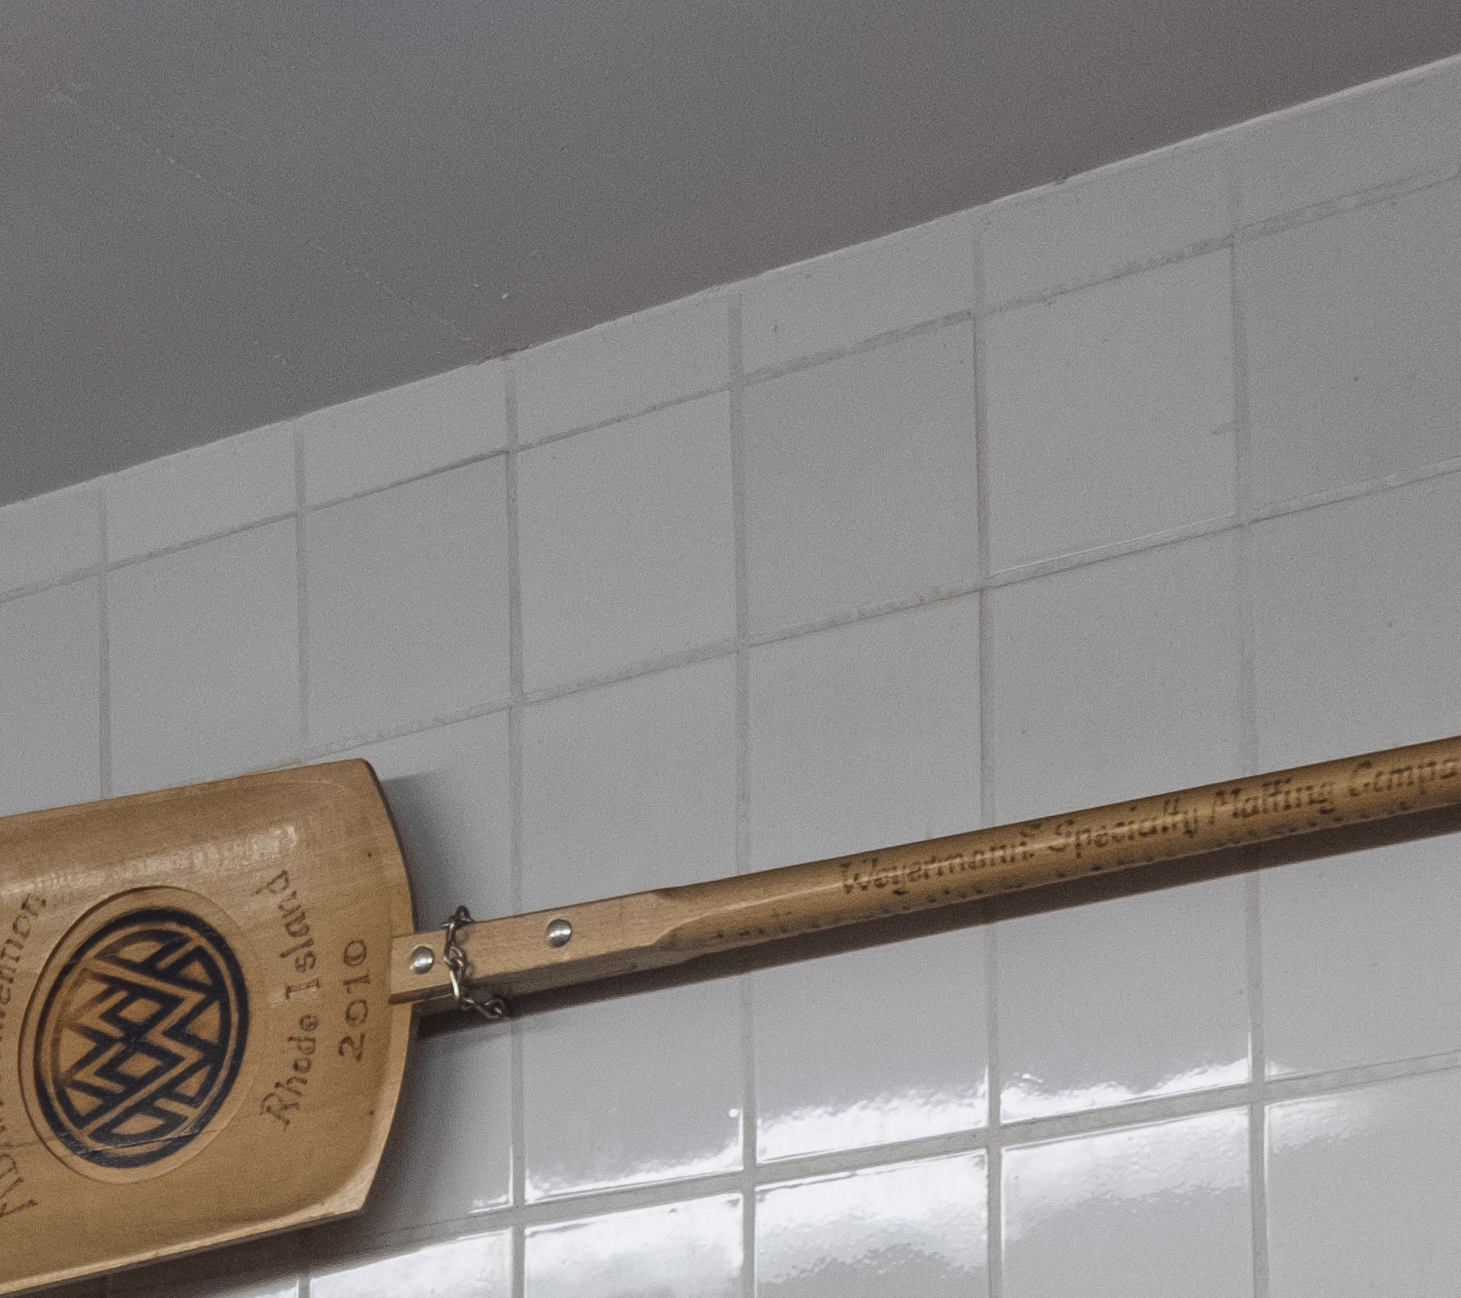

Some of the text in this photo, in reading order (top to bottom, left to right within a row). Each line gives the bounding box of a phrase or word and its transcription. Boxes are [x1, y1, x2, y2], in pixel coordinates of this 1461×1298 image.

[1047, 793, 1202, 860] Specialty
[1206, 775, 1337, 826] Malting
[252, 867, 323, 1134] Rhode Island
[336, 937, 373, 1063] 2010
